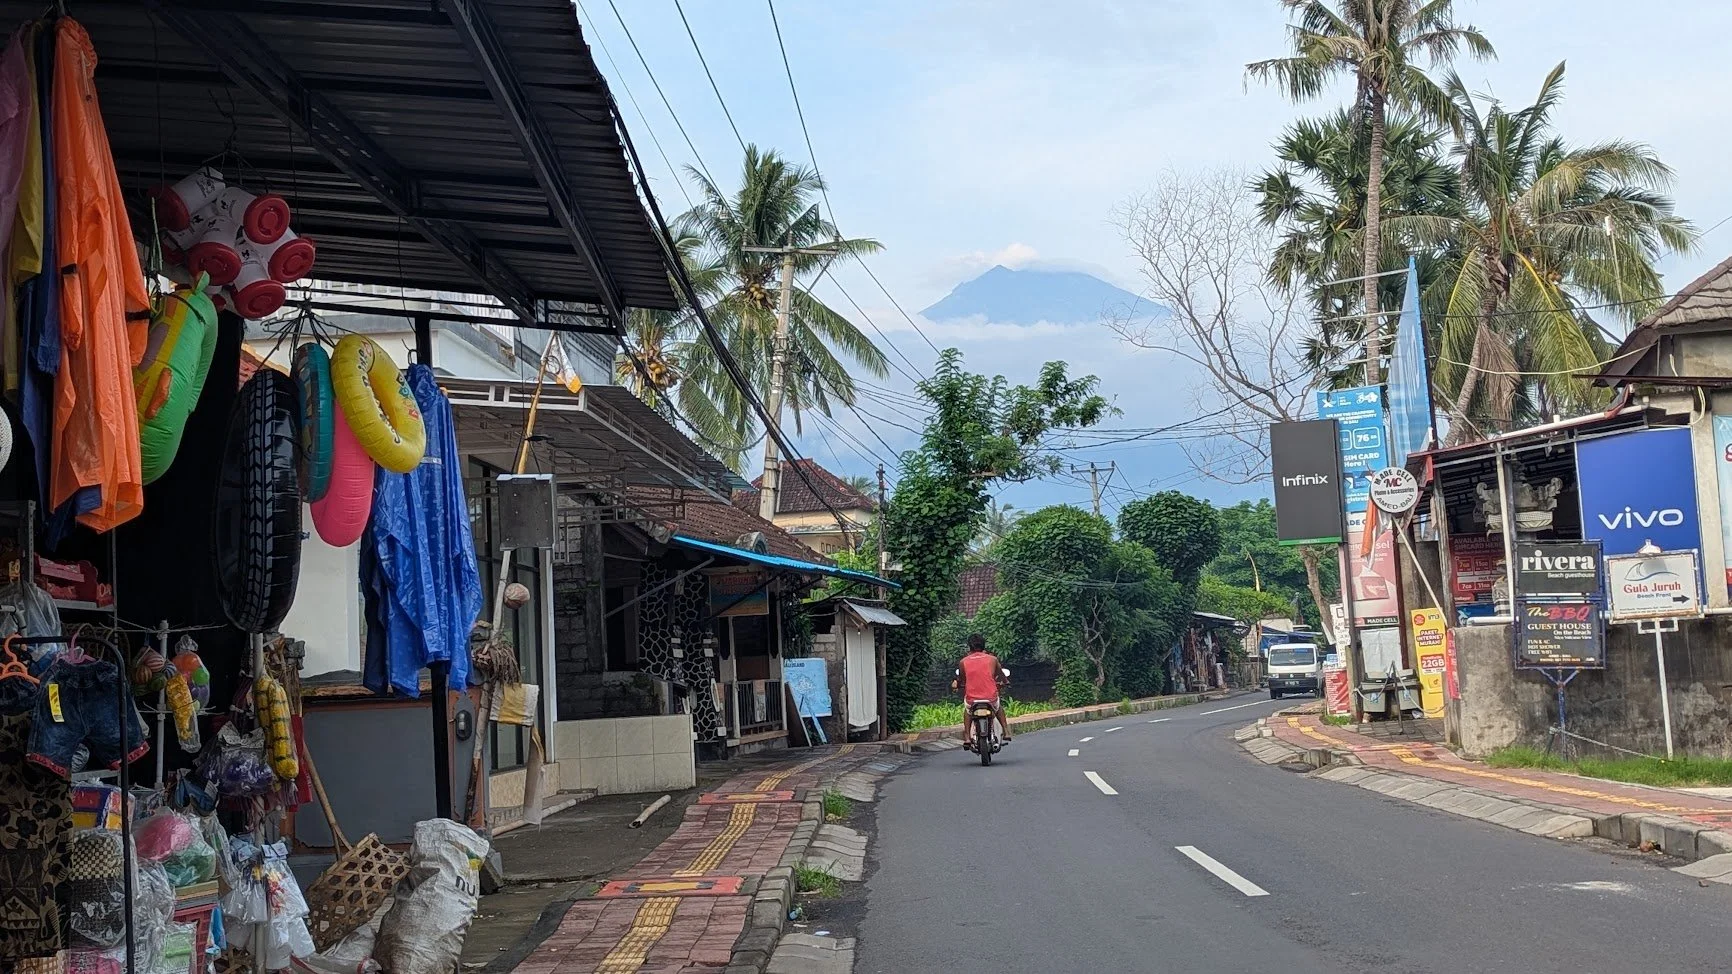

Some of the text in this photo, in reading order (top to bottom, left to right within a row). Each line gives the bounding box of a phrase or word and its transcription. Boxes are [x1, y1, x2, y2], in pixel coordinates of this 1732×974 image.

[1356, 434, 1369, 443] 76
[1343, 452, 1380, 462] SIM CARD
[1282, 473, 1329, 487] Infinix
[1374, 468, 1412, 485] MADE CELL
[1383, 478, 1402, 488] MC
[1377, 494, 1413, 510] AMED-BALI
[1598, 506, 1684, 530] vivo
[1521, 550, 1596, 571] rivera
[1623, 581, 1681, 594] Gula Juruh
[1526, 605, 1589, 621] The BBQ
[1527, 622, 1592, 631] GUEST HOUSE
[1422, 658, 1445, 669] 22GB
